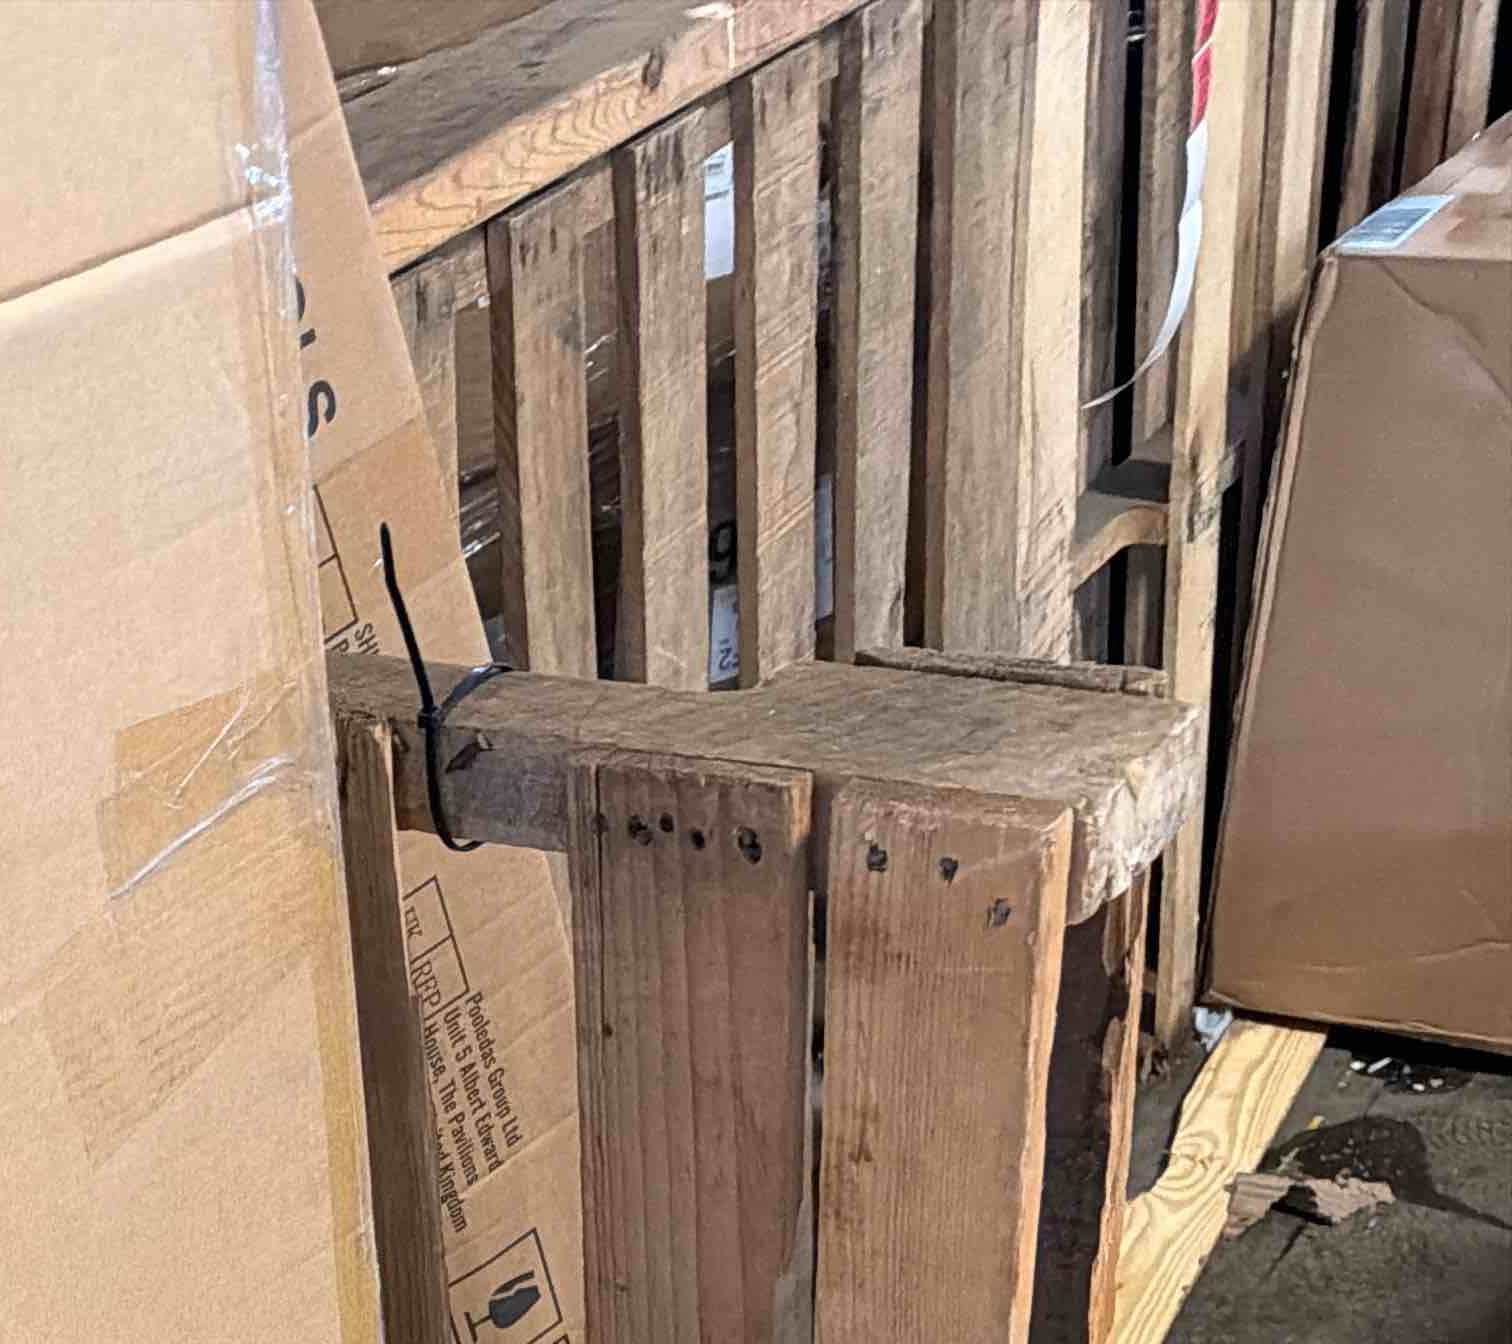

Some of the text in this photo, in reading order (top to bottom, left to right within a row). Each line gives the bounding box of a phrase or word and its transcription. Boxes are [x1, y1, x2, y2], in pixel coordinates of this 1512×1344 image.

[424, 1023, 446, 1084] House,
[439, 1078, 457, 1114] The
[448, 1112, 479, 1186] Pavilions
[444, 1007, 504, 1173] Unit 5 Albert Edward
[465, 992, 522, 1147] Pooledas Group Ltd
[439, 1161, 467, 1233] Kingdom
